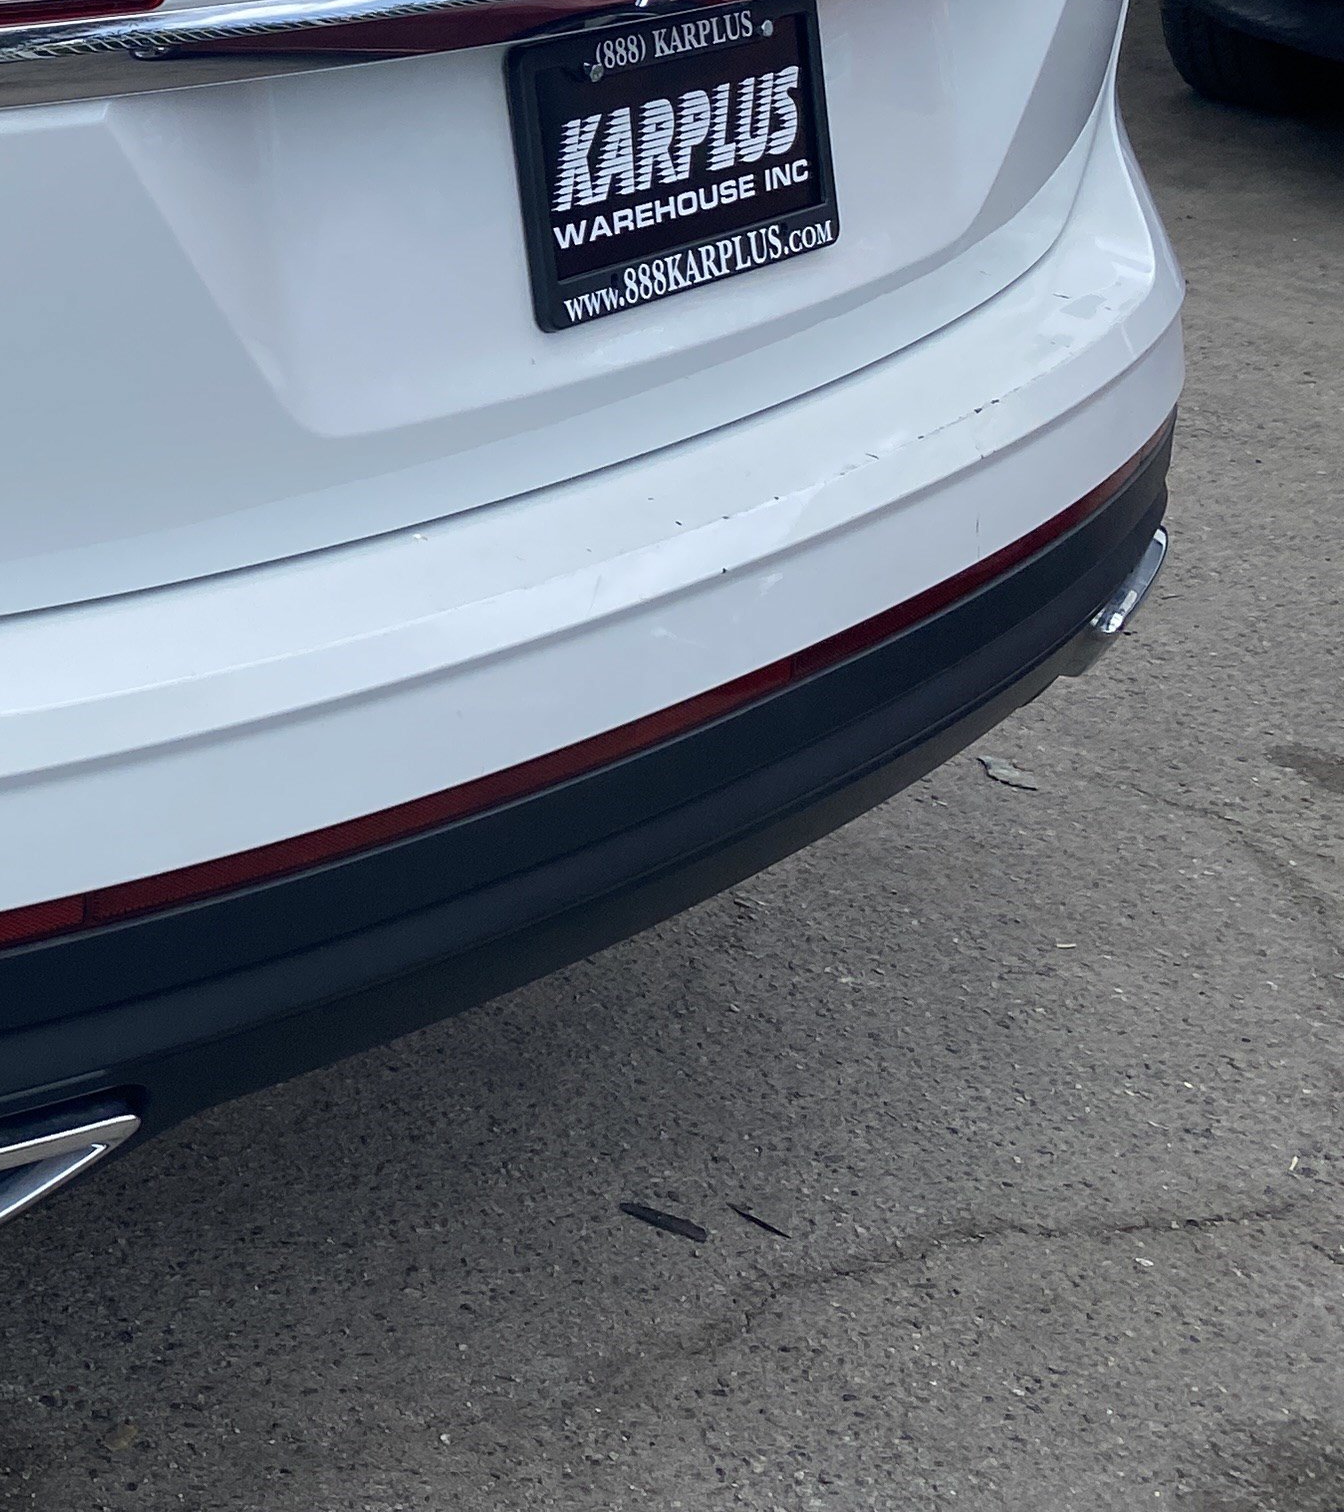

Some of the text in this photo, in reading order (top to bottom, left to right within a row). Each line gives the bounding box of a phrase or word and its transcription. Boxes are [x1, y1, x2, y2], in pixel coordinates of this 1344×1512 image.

[595, 10, 754, 70] (888) KARPLUS
[551, 64, 800, 213] KARPLUS
[552, 159, 810, 250] WAREHOUSE INC
